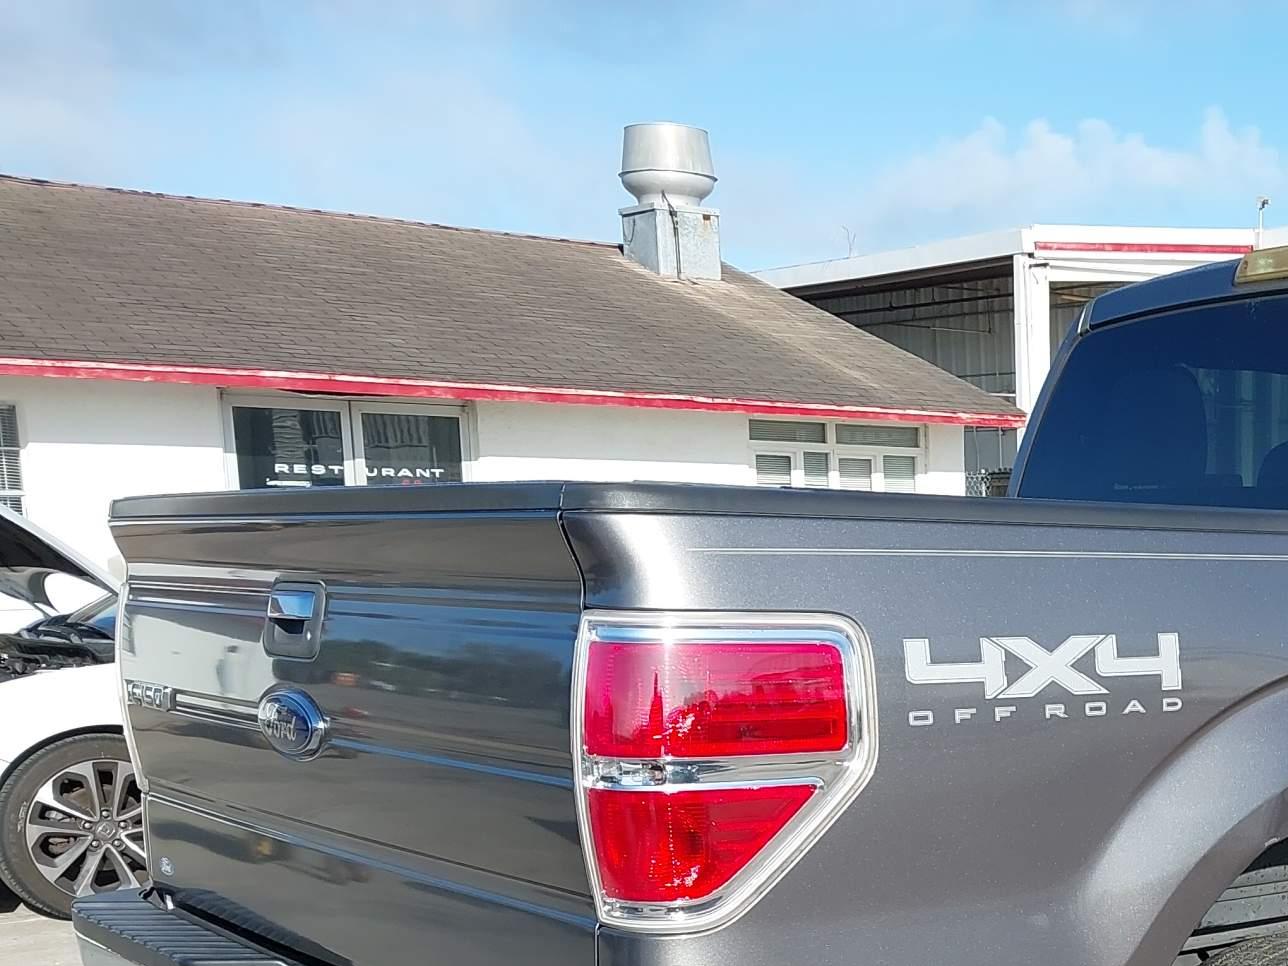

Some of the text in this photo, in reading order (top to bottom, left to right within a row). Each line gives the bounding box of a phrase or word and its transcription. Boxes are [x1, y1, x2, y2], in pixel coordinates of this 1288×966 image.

[274, 463, 445, 478] RESTURANT
[907, 697, 1183, 727] OFF ROAD
